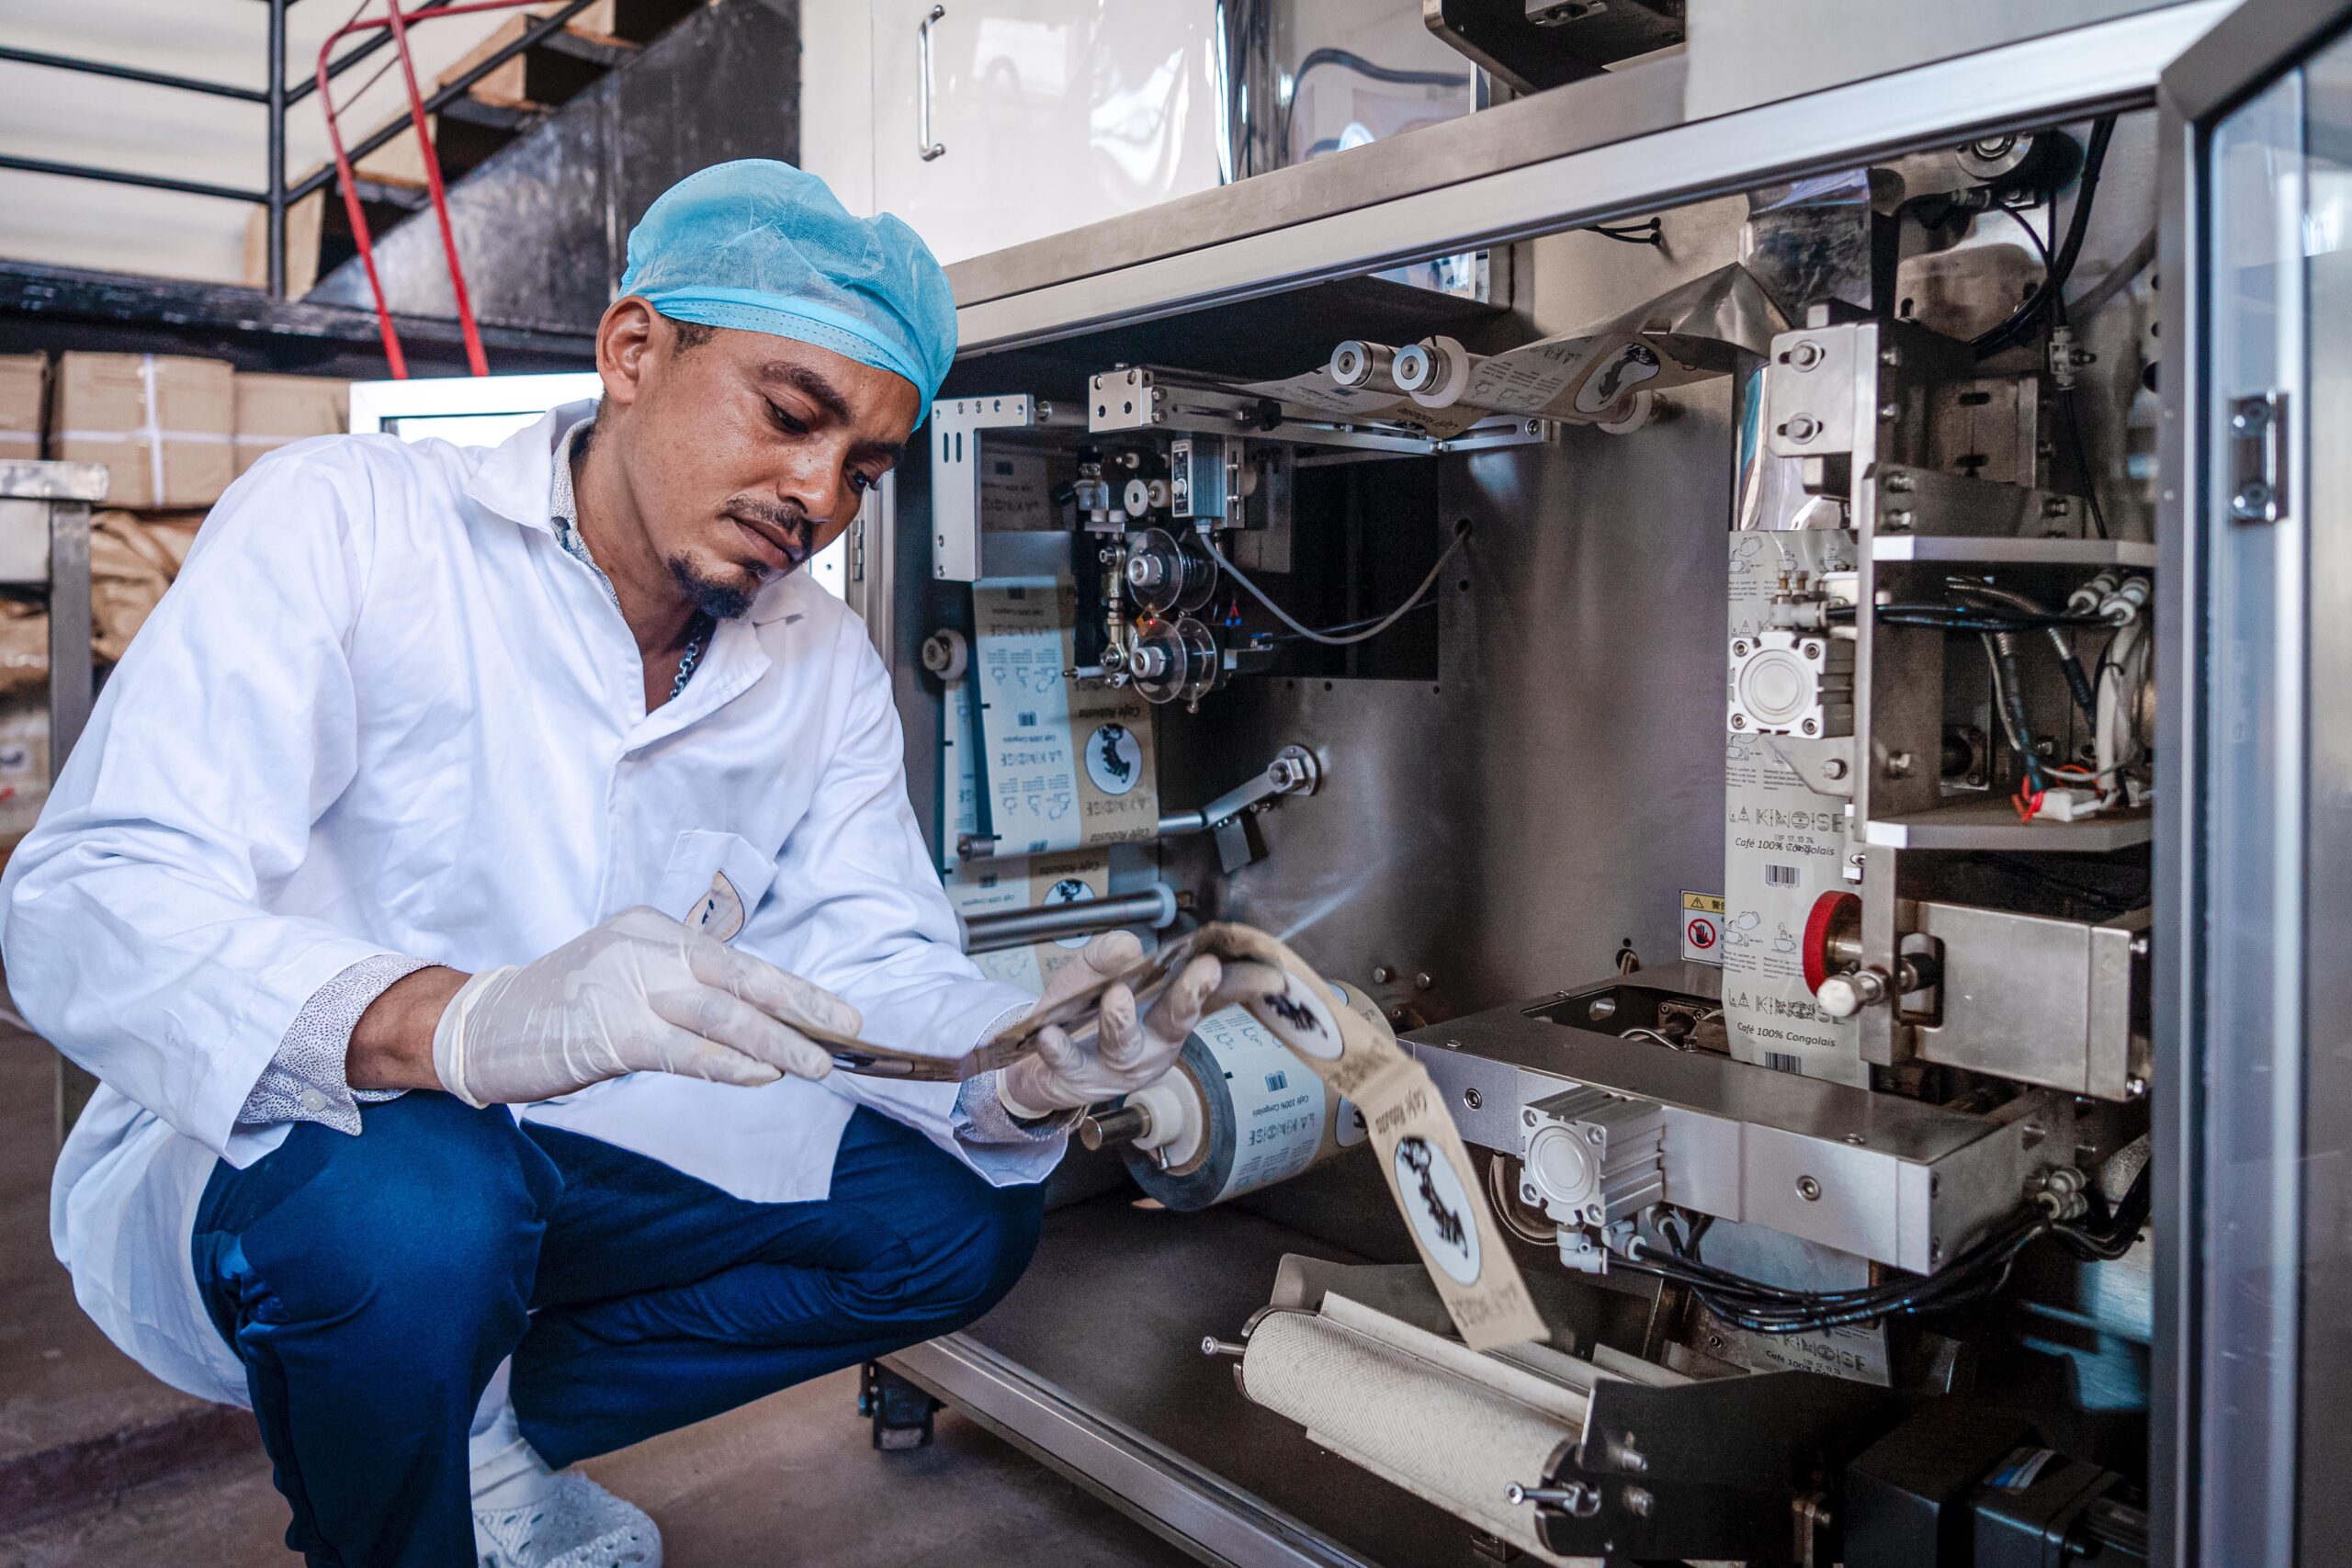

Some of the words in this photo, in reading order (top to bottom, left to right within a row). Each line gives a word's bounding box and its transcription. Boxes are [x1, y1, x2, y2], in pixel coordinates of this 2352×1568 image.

[1729, 805, 1750, 824] LA
[1756, 807, 1845, 833] KINOISE
[1736, 837, 1755, 848] Café
[1758, 840, 1783, 851] 100%
[1728, 988, 1751, 1010] LA
[1737, 1021, 1755, 1034] Café
[1757, 1027, 1783, 1039] 100%
[1786, 1032, 1836, 1047] Congolais
[1251, 1100, 1280, 1118] Congolais
[1280, 1097, 1295, 1111] 100%
[1295, 1094, 1309, 1107] Café
[1299, 1111, 1316, 1132] LA
[1248, 1118, 1297, 1146] KINOISE
[1766, 1349, 1785, 1363] Café
